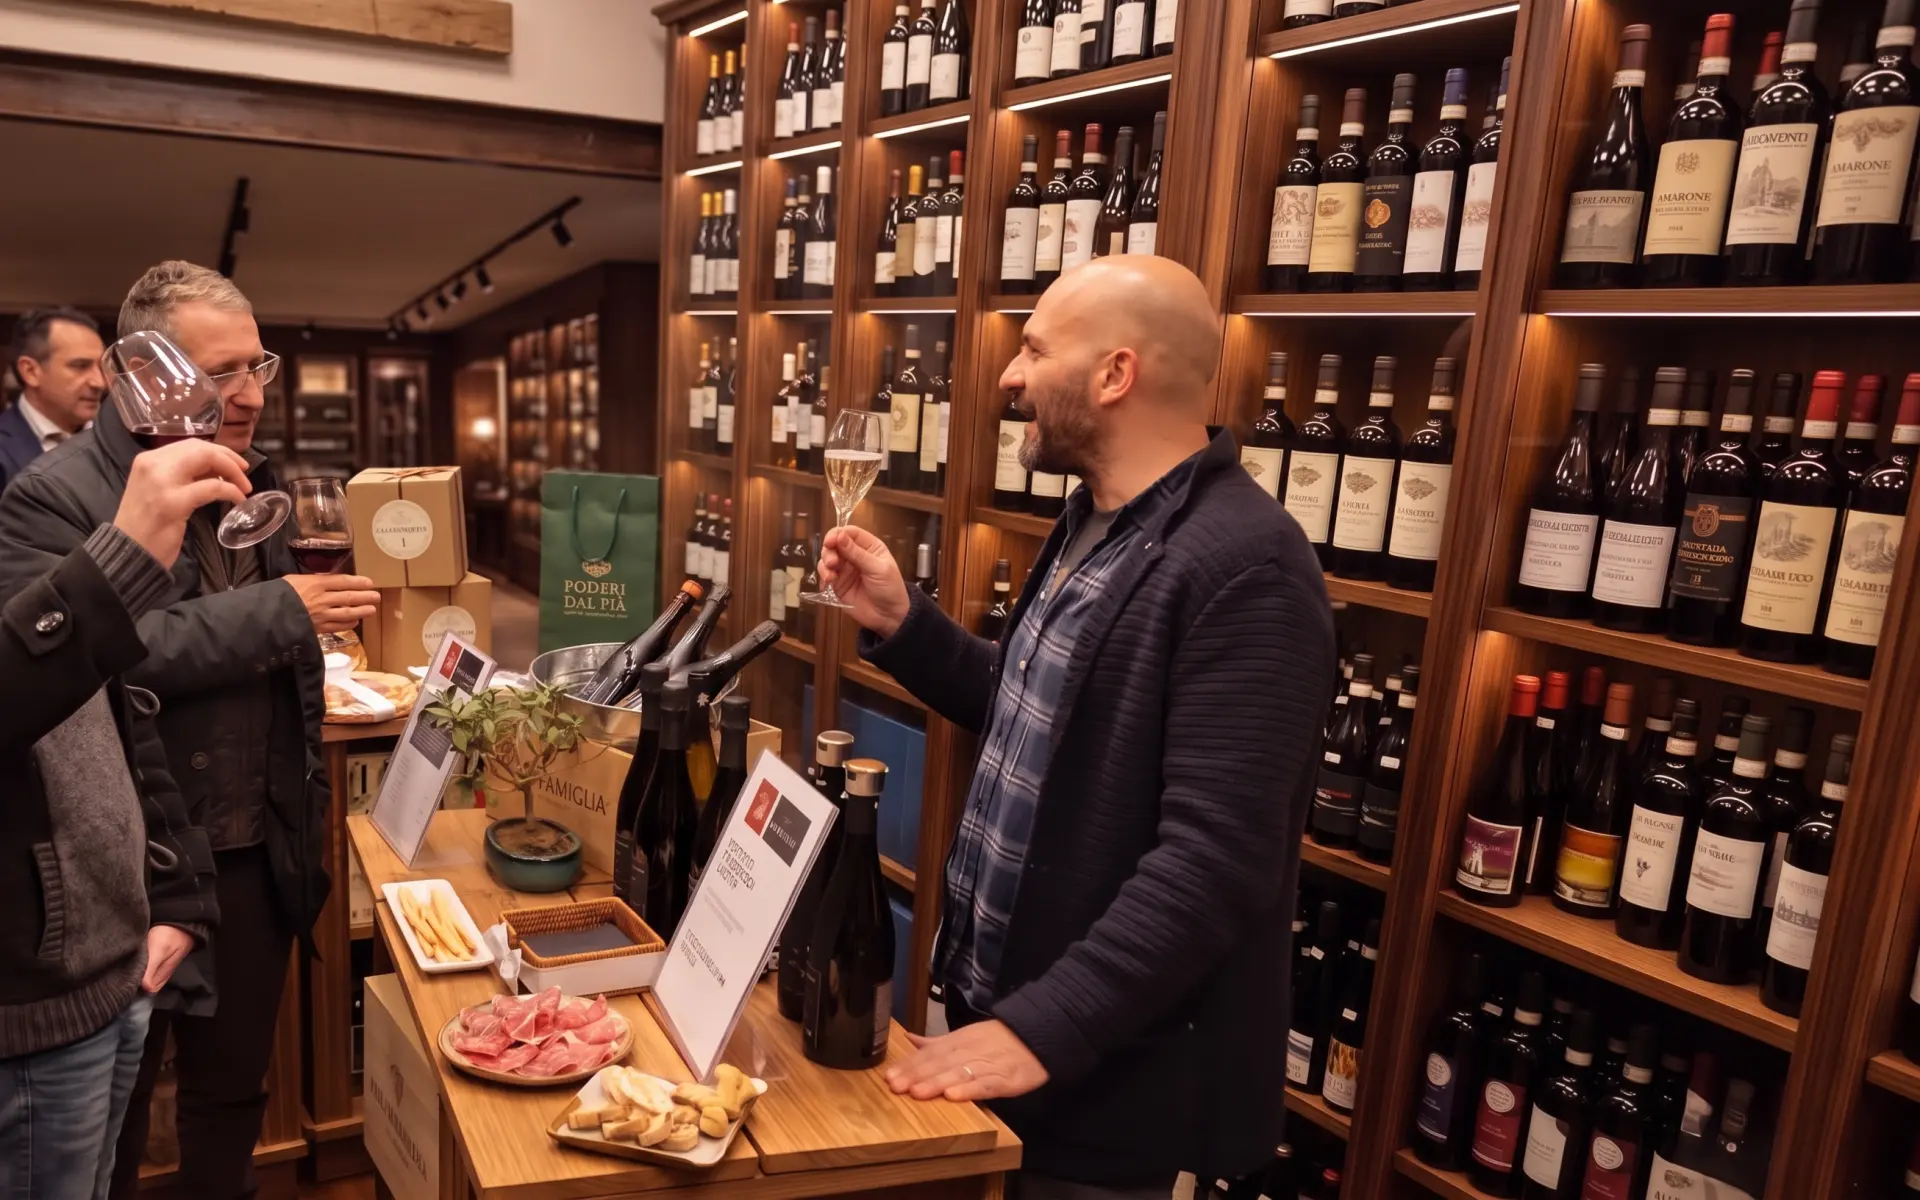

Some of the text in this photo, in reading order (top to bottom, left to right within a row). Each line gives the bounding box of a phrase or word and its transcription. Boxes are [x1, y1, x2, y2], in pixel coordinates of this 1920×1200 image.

[1831, 160, 1892, 172] AMARONE
[1658, 192, 1711, 202] AMARONE
[564, 580, 626, 595] PODERI
[564, 595, 626, 611] DAL PIÀ
[539, 776, 606, 816] FAMIGLIA
